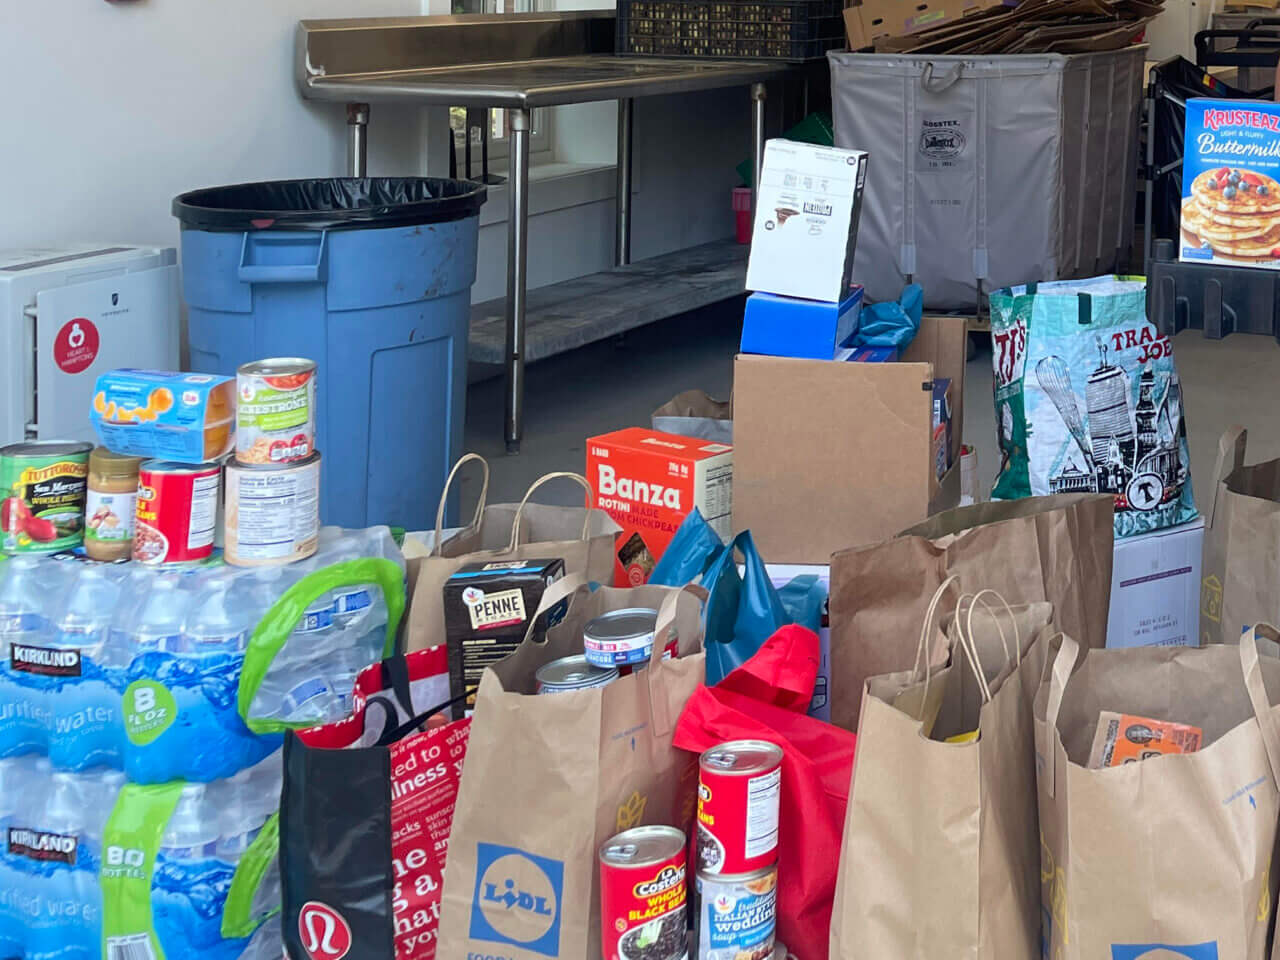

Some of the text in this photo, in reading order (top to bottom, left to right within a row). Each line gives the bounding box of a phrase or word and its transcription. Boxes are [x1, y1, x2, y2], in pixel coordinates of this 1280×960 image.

[598, 464, 681, 510] Banza
[598, 497, 660, 519] ROTINI MADE
[474, 596, 520, 618] PENNE
[134, 687, 156, 713] 8
[55, 706, 113, 735] water
[144, 708, 168, 720] OZ
[421, 745, 440, 763] to
[107, 845, 145, 868] 80
[628, 905, 666, 921] BLACK
